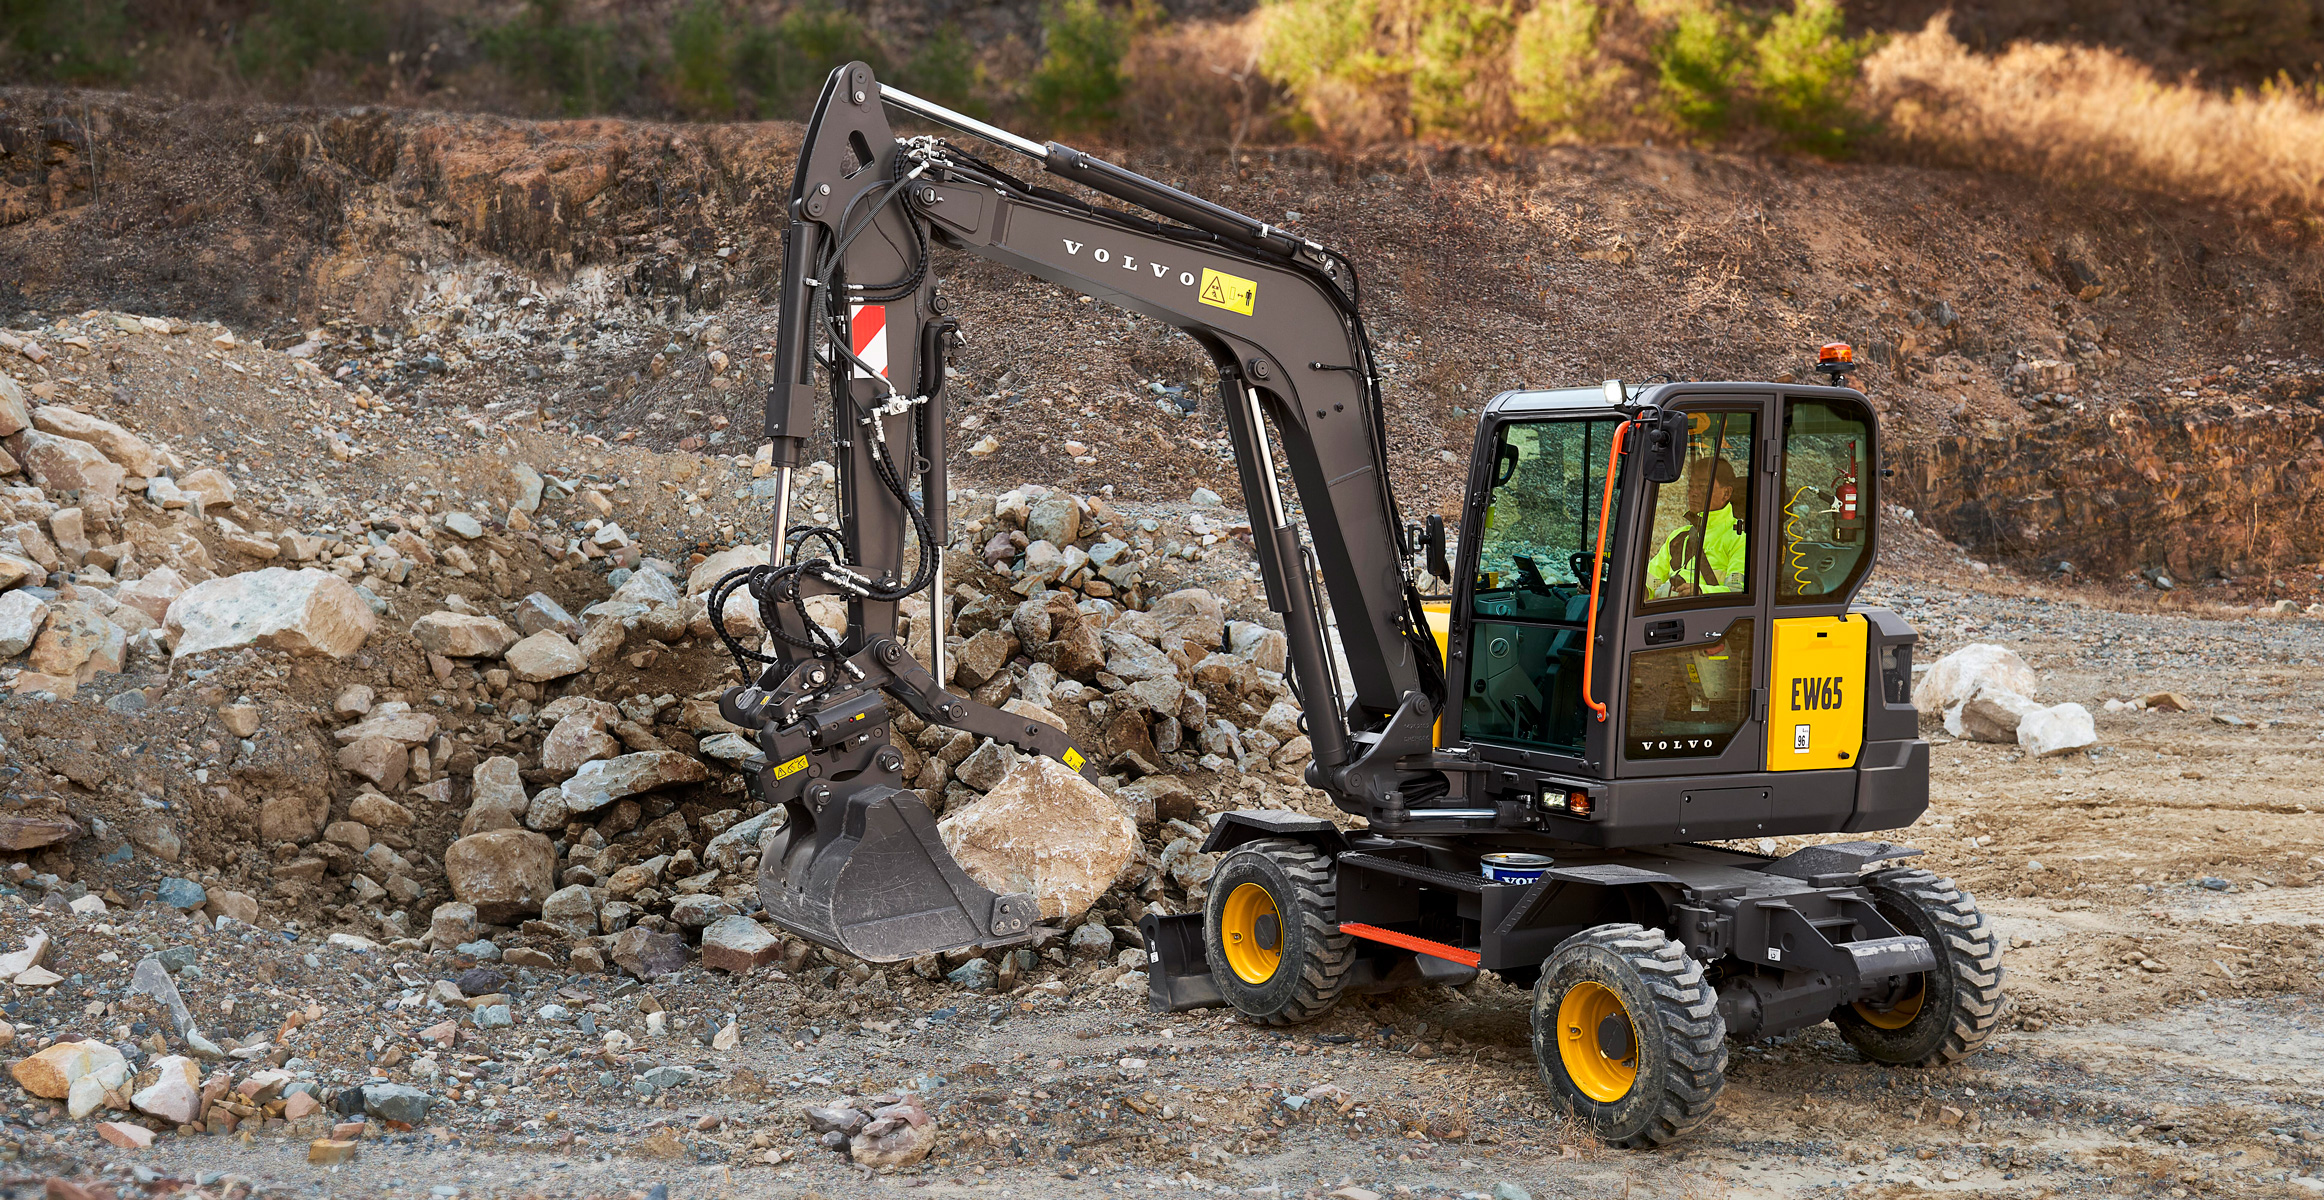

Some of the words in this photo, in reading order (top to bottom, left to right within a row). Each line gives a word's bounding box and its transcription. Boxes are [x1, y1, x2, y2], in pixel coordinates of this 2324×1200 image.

[1062, 239, 1195, 286] VOLVO
[1791, 676, 1843, 711] EW65
[1641, 739, 1713, 751] VOLVO
[1797, 735, 1806, 747] 96
